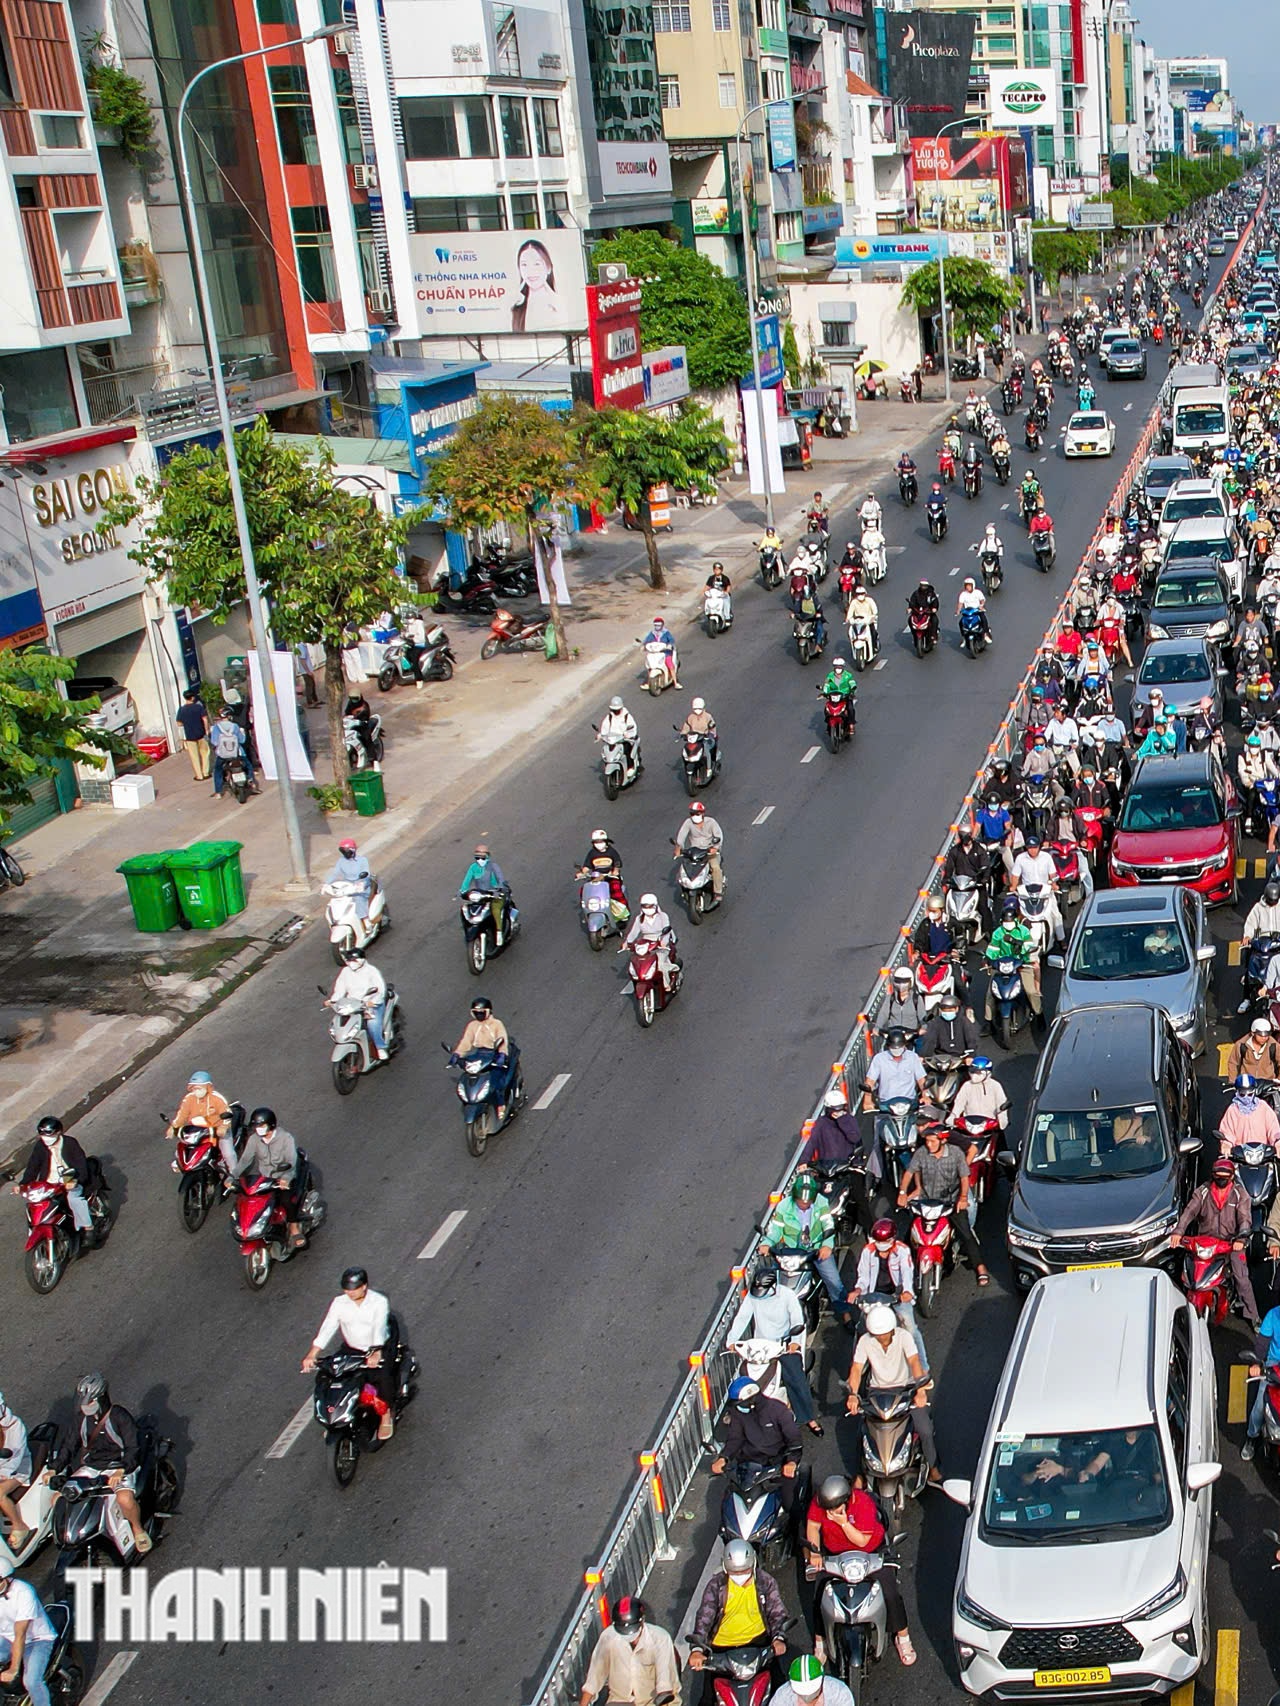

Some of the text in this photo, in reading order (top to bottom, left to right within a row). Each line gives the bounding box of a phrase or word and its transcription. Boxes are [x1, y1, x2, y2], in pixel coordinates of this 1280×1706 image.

[873, 244, 929, 253] VIETBANK
[452, 253, 478, 262] PARIS
[459, 273, 479, 281] NHA
[481, 272, 507, 281] KHOA
[417, 286, 505, 301] CHUẨN PHÁP
